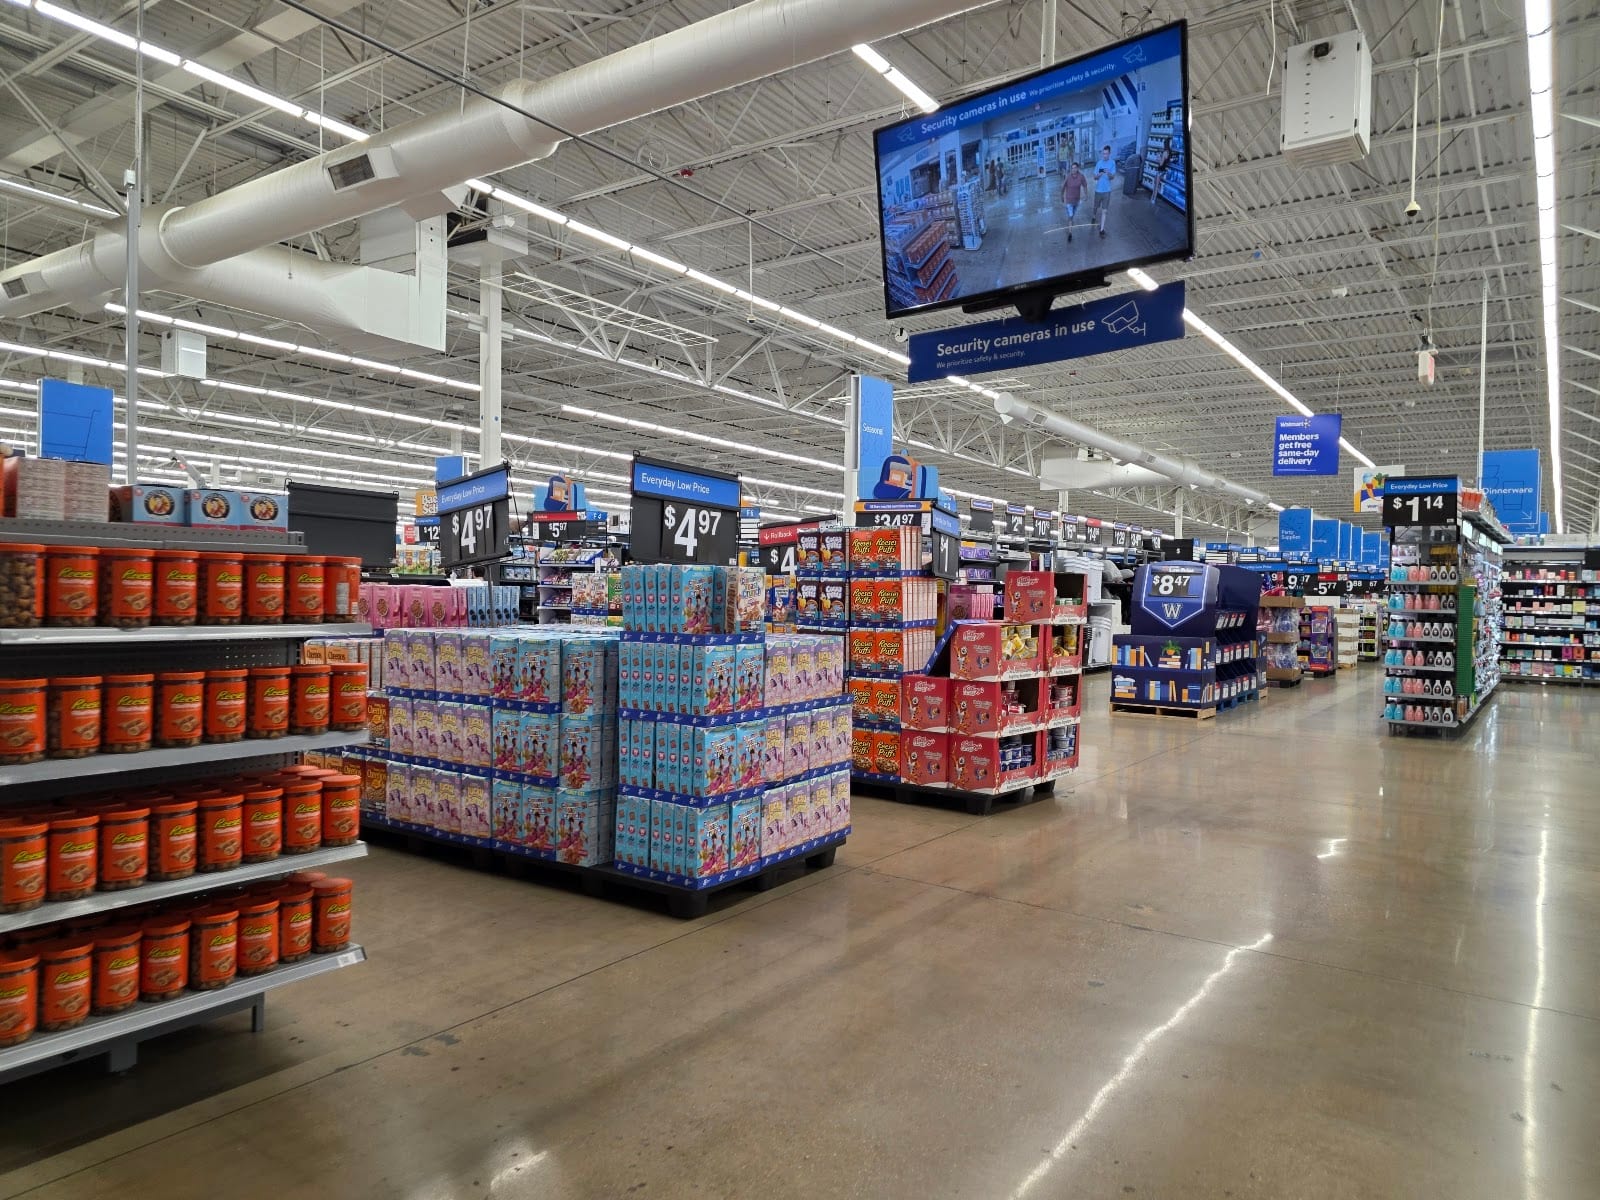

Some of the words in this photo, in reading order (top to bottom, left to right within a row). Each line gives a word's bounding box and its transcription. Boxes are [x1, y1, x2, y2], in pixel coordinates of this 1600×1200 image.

[922, 116, 958, 134] Security
[959, 102, 996, 120] cameras
[998, 96, 1008, 107] in
[1010, 92, 1026, 104] use
[1029, 90, 1038, 98] We
[1066, 74, 1084, 86] safety
[937, 338, 990, 356] Security
[994, 330, 1050, 347] cameras
[1055, 324, 1067, 336] in
[1072, 320, 1096, 334] use
[974, 354, 992, 365] safety
[1278, 442, 1294, 450] get
[1278, 449, 1320, 458] same-day
[1278, 458, 1312, 466] delivery
[641, 472, 676, 490] Everyday
[677, 480, 691, 491] Low
[693, 482, 710, 494] Price
[442, 493, 462, 504] Everyday
[462, 489, 472, 498] Low
[473, 486, 485, 494] Price
[854, 546, 870, 554] Puffs
[878, 546, 895, 554] Puffs
[855, 596, 871, 605] Puffs
[880, 597, 897, 605] Puffs
[1162, 602, 1183, 619] W
[880, 648, 899, 656] Puffs
[853, 746, 868, 754] Puffs
[878, 748, 895, 757] Puffs
